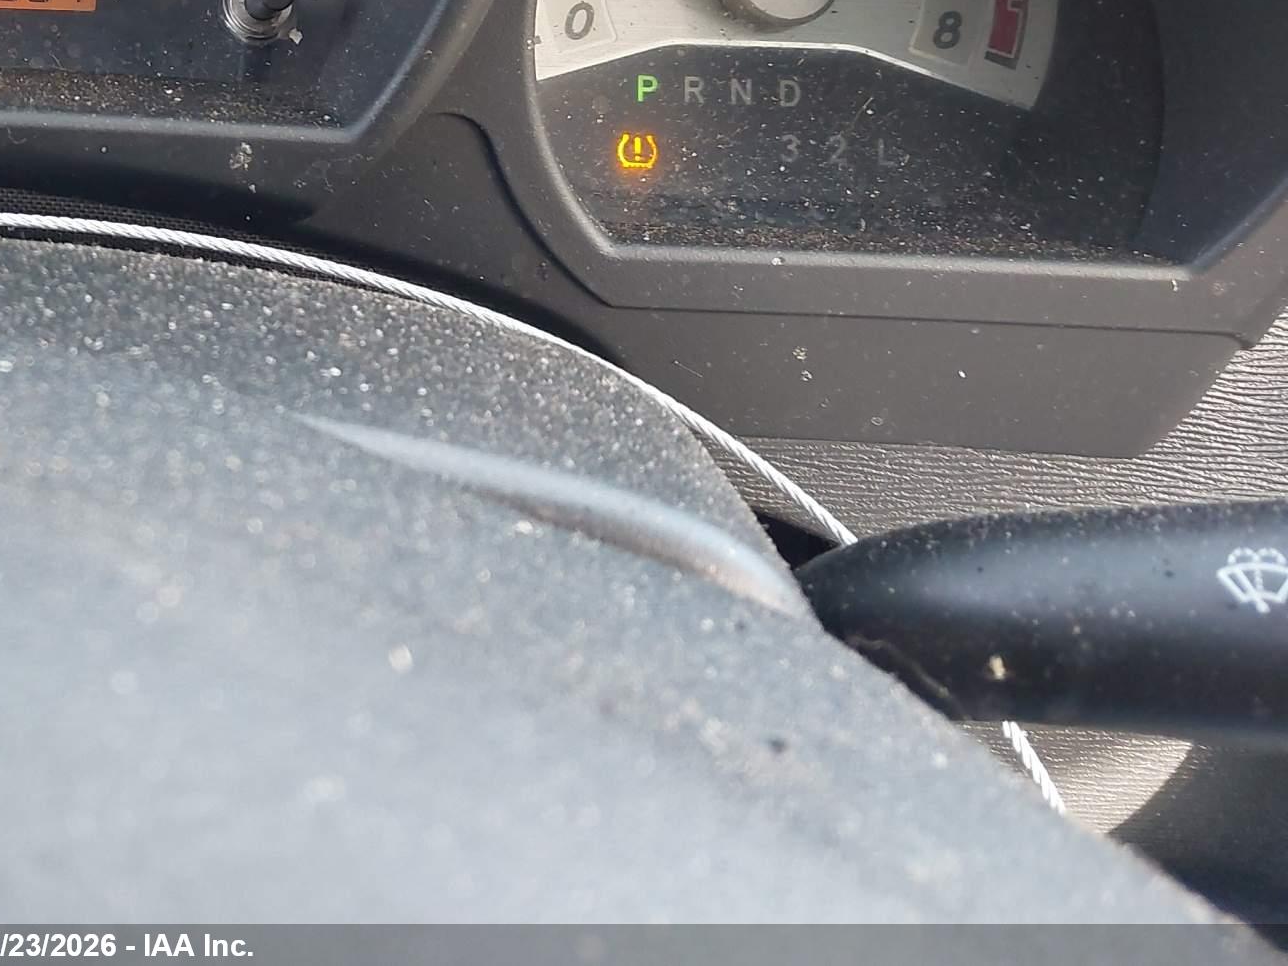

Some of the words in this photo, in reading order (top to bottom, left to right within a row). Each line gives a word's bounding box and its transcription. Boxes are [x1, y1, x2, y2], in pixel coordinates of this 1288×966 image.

[564, 1, 595, 40] 0
[932, 10, 962, 49] 8
[636, 74, 659, 103] P
[683, 76, 705, 104] R
[729, 78, 752, 105] N
[778, 80, 801, 107] D
[780, 134, 800, 163] 3
[827, 135, 849, 166] 2
[877, 137, 898, 166] L
